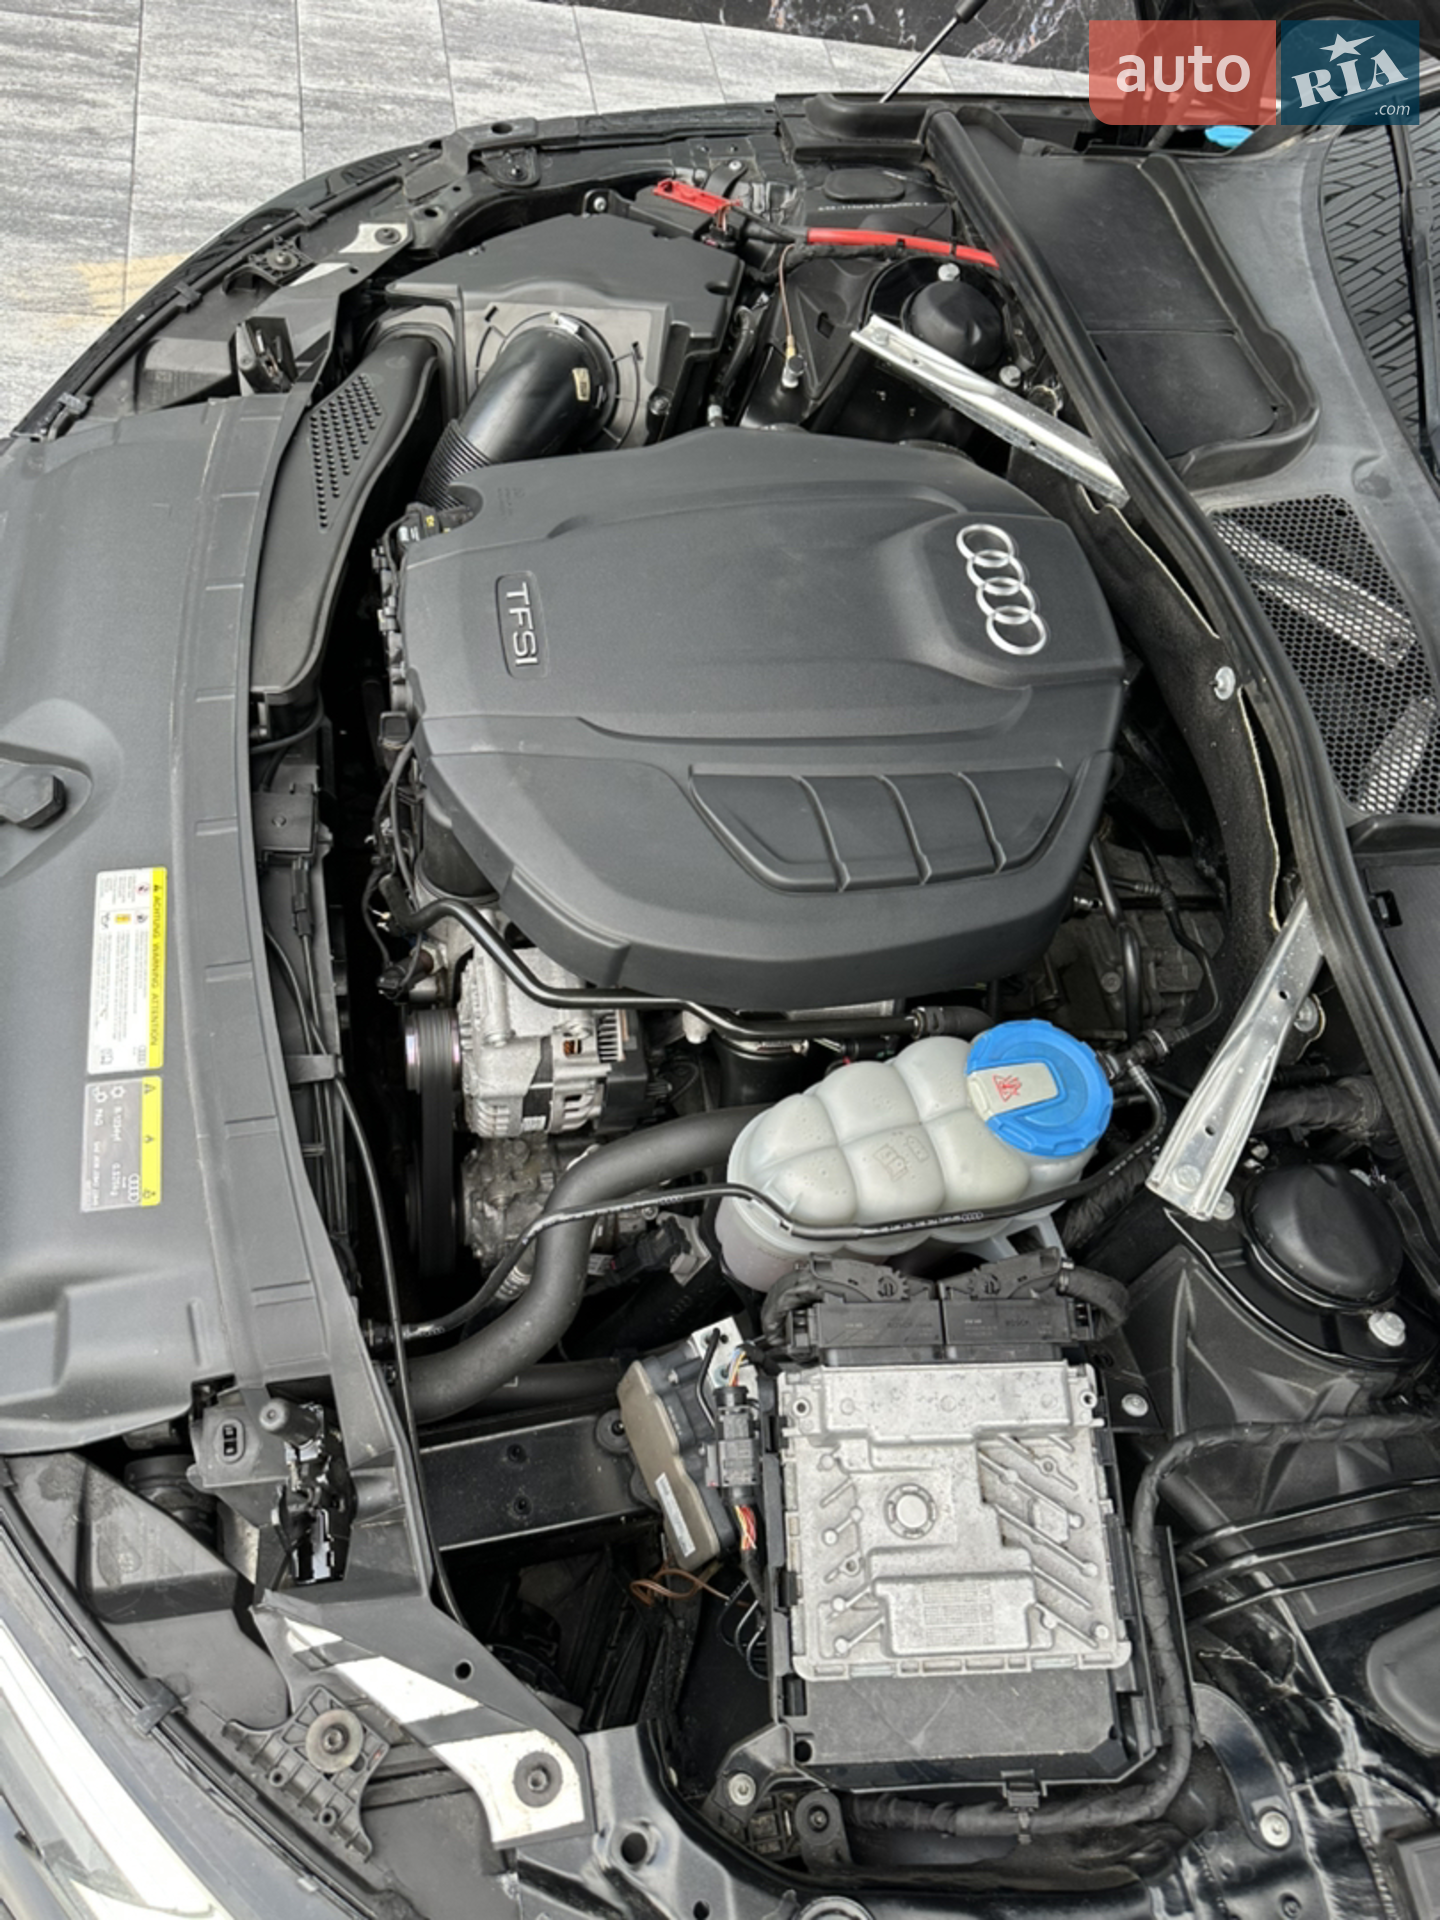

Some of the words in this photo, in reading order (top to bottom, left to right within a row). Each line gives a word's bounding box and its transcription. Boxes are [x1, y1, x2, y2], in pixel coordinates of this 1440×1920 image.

[506, 582, 538, 665] TFSI
[152, 896, 161, 939] ACHTUNG
[151, 942, 160, 988] WARNING
[150, 993, 159, 1046] ATTENTION
